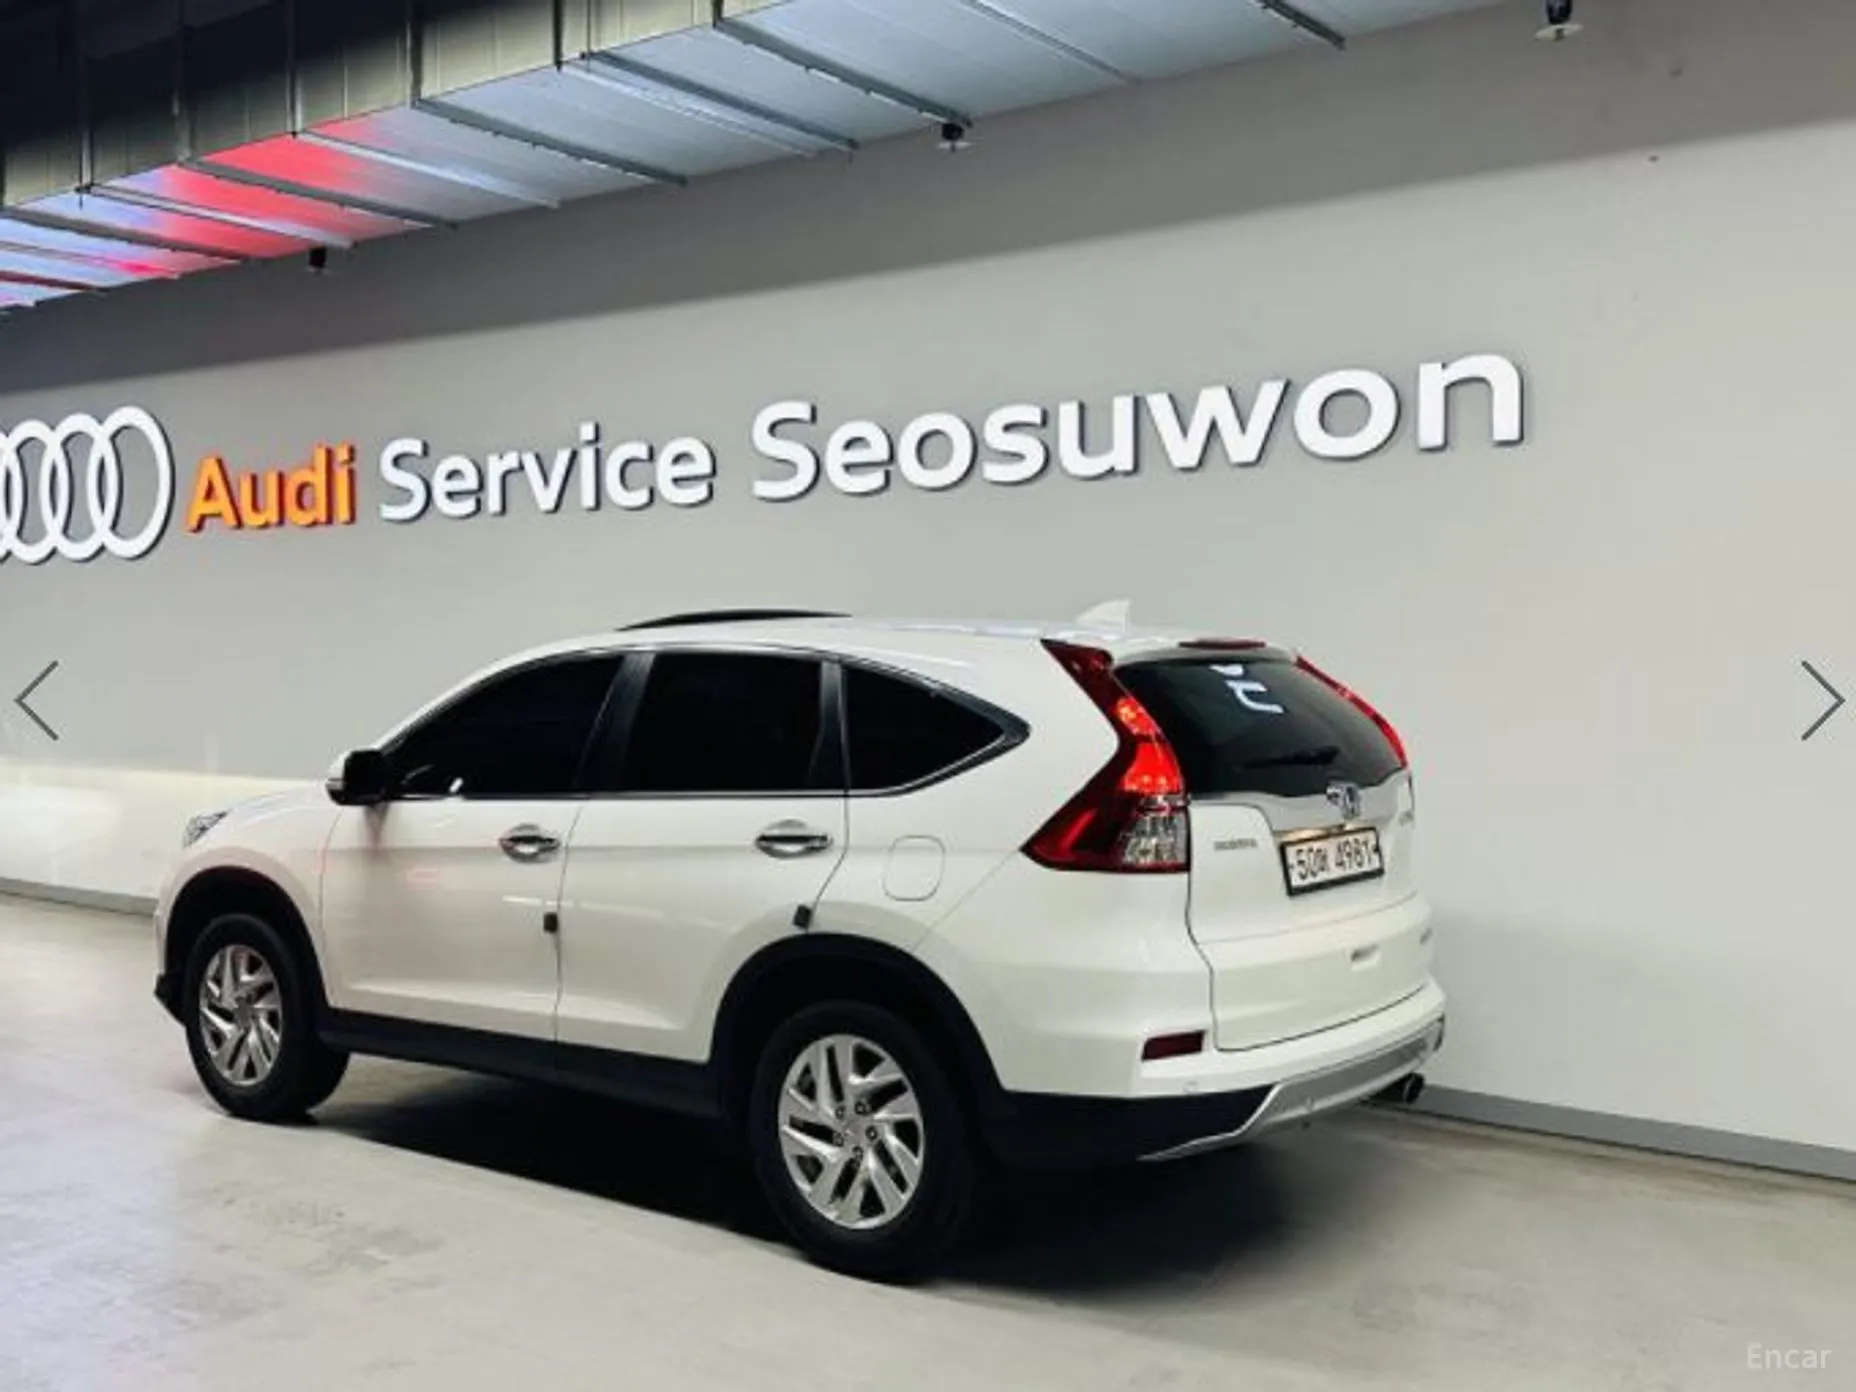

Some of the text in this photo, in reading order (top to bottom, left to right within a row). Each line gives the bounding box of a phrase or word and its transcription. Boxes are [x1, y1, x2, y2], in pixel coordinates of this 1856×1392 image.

[188, 352, 1526, 532] Audi Service Seosuwon
